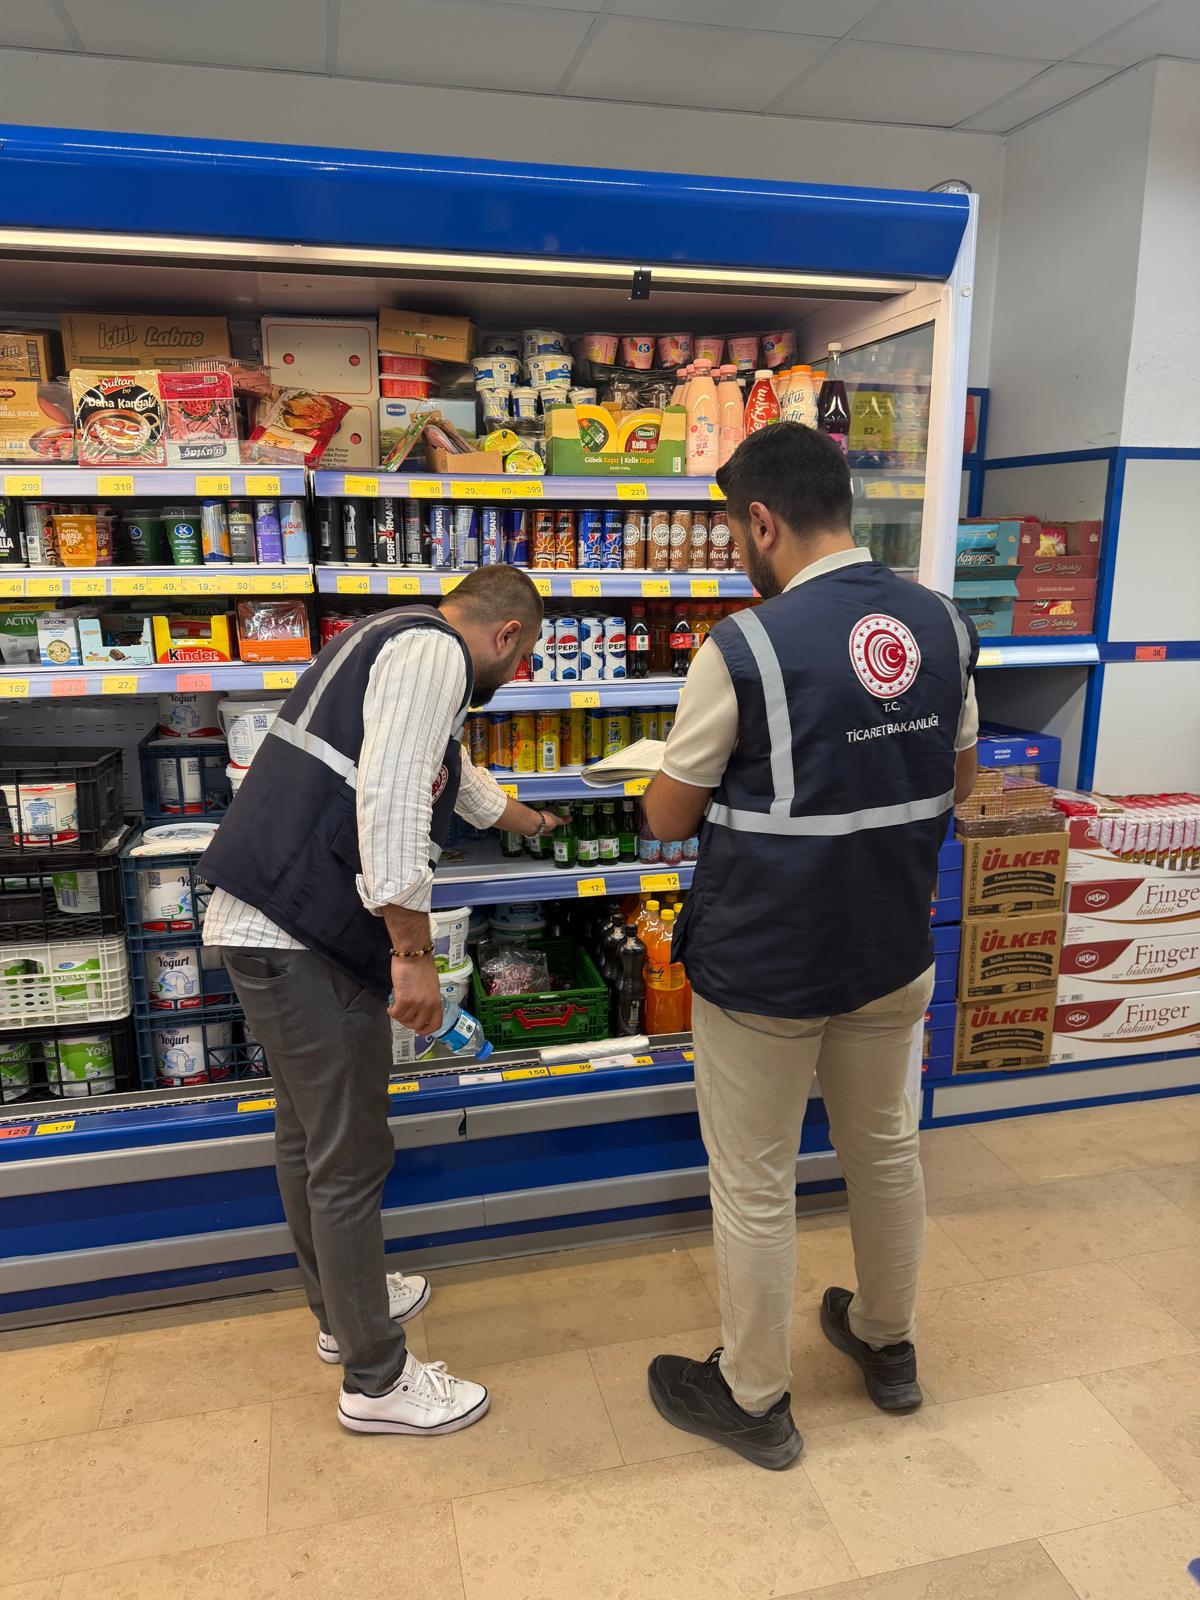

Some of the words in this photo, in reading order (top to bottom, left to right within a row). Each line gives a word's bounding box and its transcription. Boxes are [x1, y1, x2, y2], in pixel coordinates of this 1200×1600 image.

[145, 326, 204, 347] Labne
[100, 377, 135, 390] Sultan
[22, 483, 40, 491] 299
[114, 483, 132, 491] 319
[217, 483, 229, 491] 89
[267, 483, 279, 491] 59
[10, 584, 22, 592] 49
[48, 584, 60, 592] 55
[133, 583, 145, 591] 45
[168, 648, 217, 662] Kinder
[8, 684, 26, 693] 159
[883, 701, 901, 712] T.C.
[981, 848, 1059, 872] ÜLKER
[980, 928, 1057, 953] ÜLKER
[1135, 944, 1199, 969] Finger
[970, 1005, 1049, 1028] ÜLKER
[1126, 1003, 1190, 1026] Finger
[158, 1034, 190, 1048] Yoğurt
